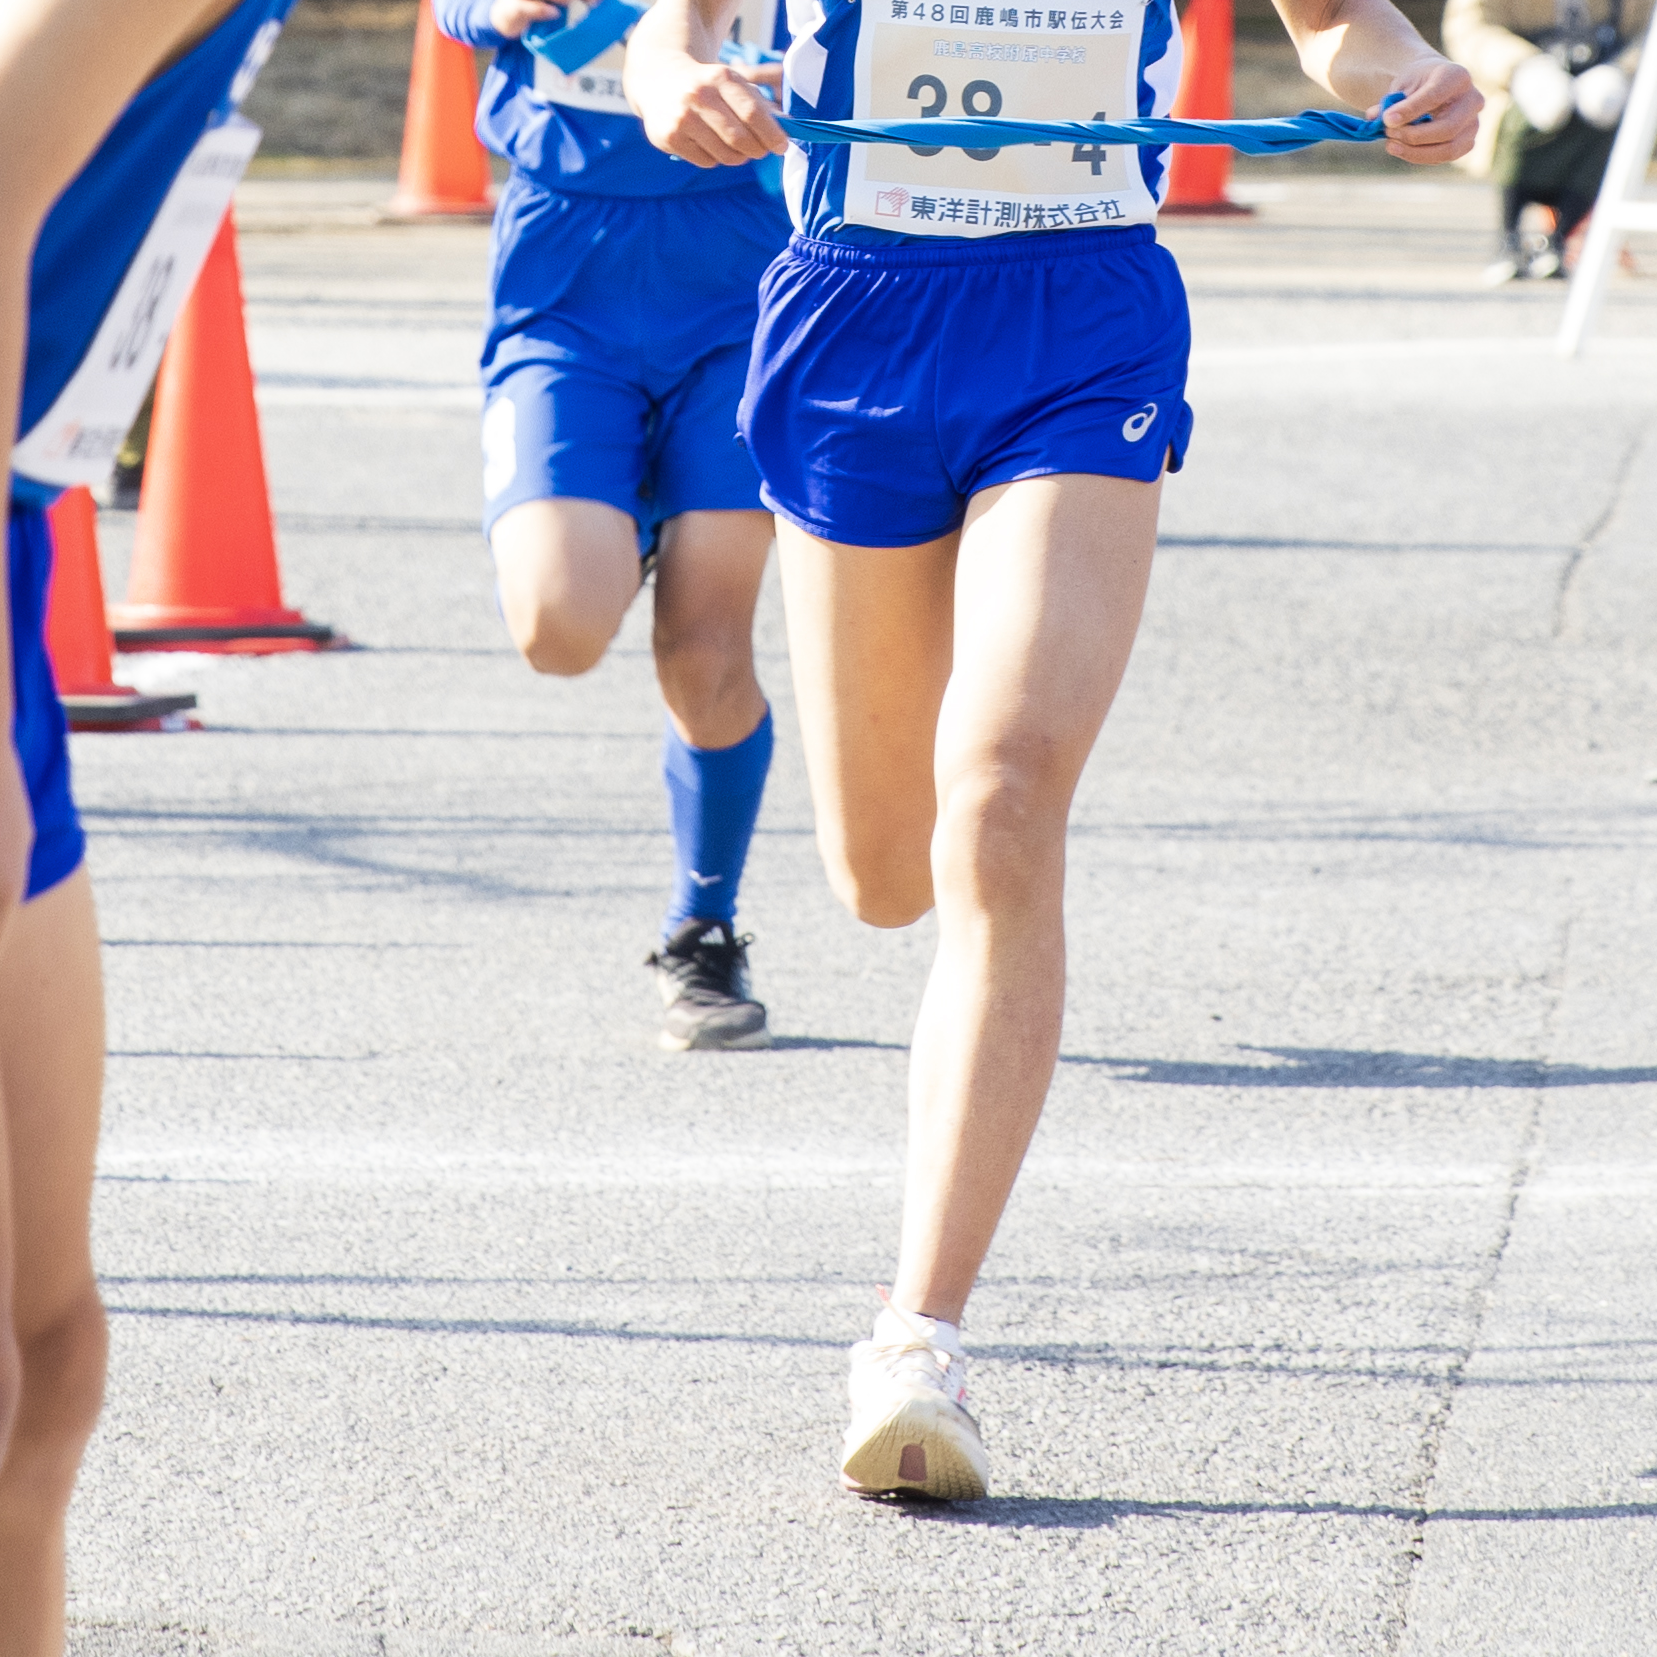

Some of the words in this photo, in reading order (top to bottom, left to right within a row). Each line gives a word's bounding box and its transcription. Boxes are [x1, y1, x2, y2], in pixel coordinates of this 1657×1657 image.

[890, 0, 1125, 31] 第48回鹿嶋市駅伝大会
[933, 39, 1087, 64] 鹿島高校附属中学校
[909, 195, 1126, 228] 東洋計測株式会社
